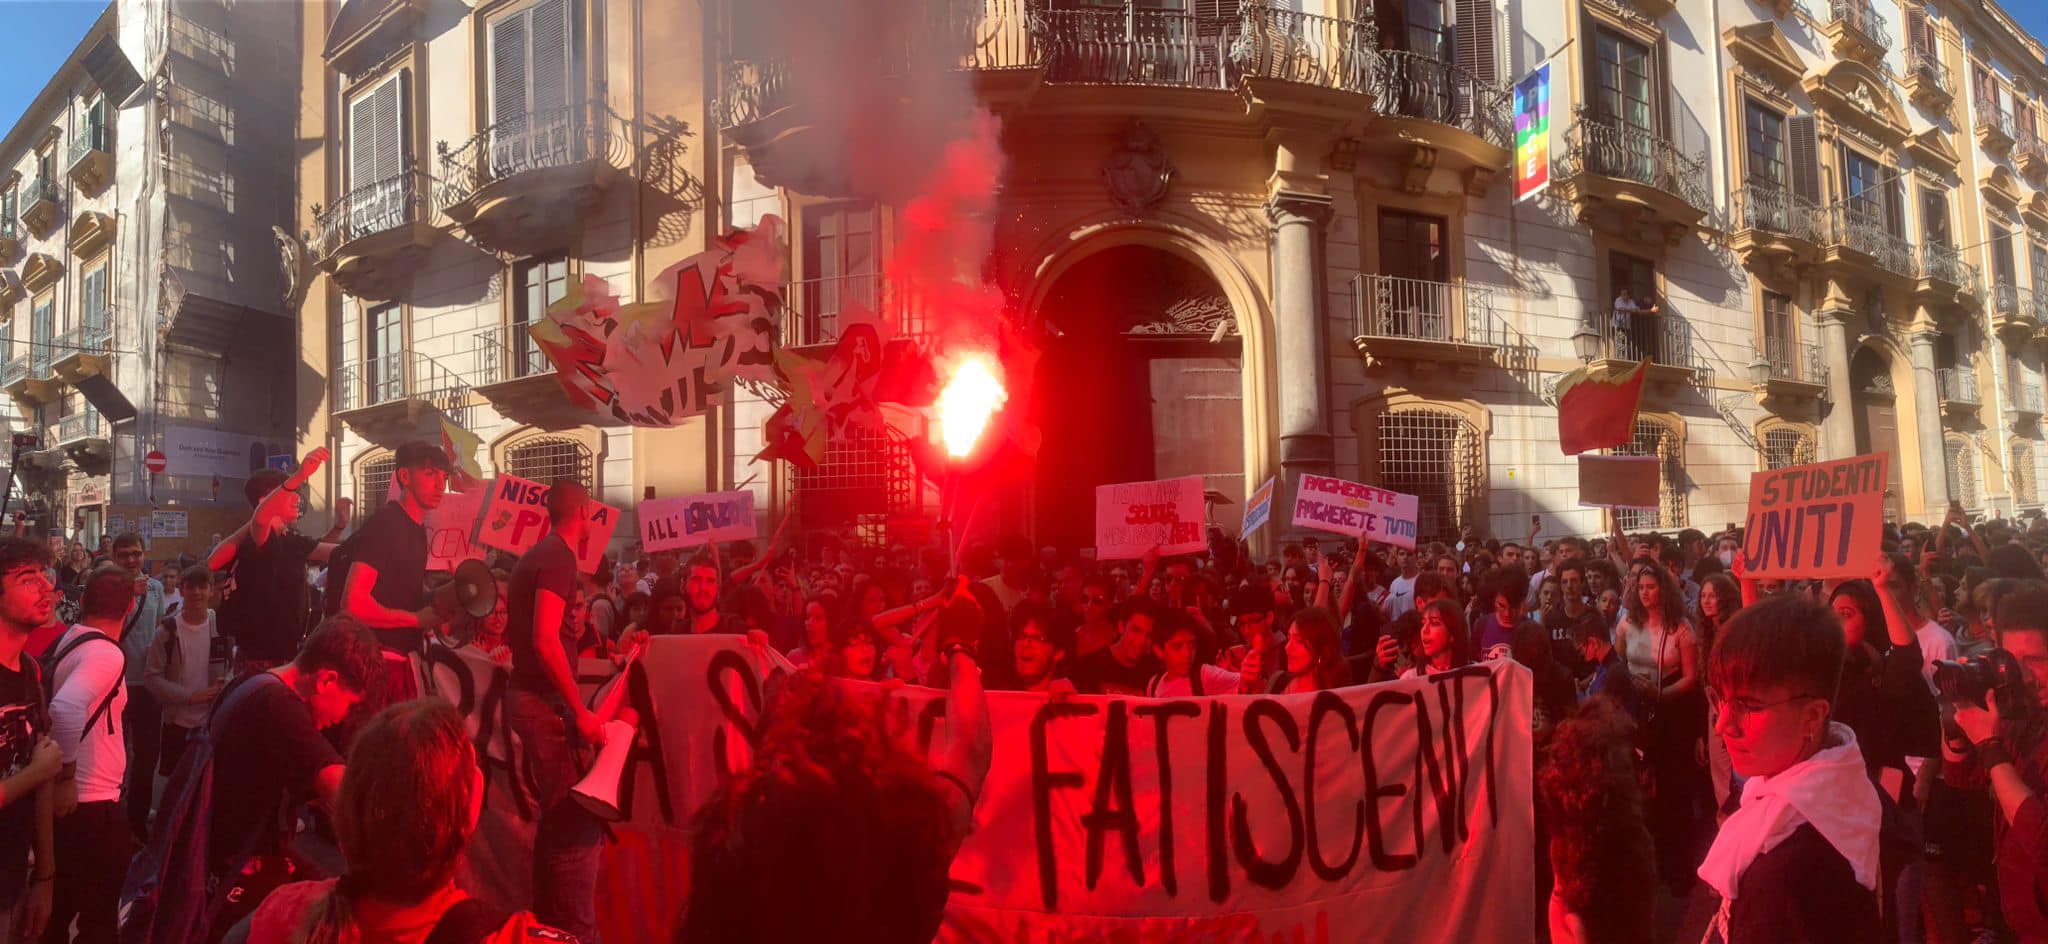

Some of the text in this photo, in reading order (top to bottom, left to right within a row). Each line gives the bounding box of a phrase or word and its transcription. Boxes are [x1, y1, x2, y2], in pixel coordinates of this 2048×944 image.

[1761, 459, 1882, 506] STUDENTI
[648, 514, 678, 541] ALL'
[1296, 499, 1377, 532] PAGHERETE
[1383, 516, 1416, 539] TUTTO
[1743, 502, 1855, 573] UNITI
[1030, 665, 1500, 910] FATISCENTI
